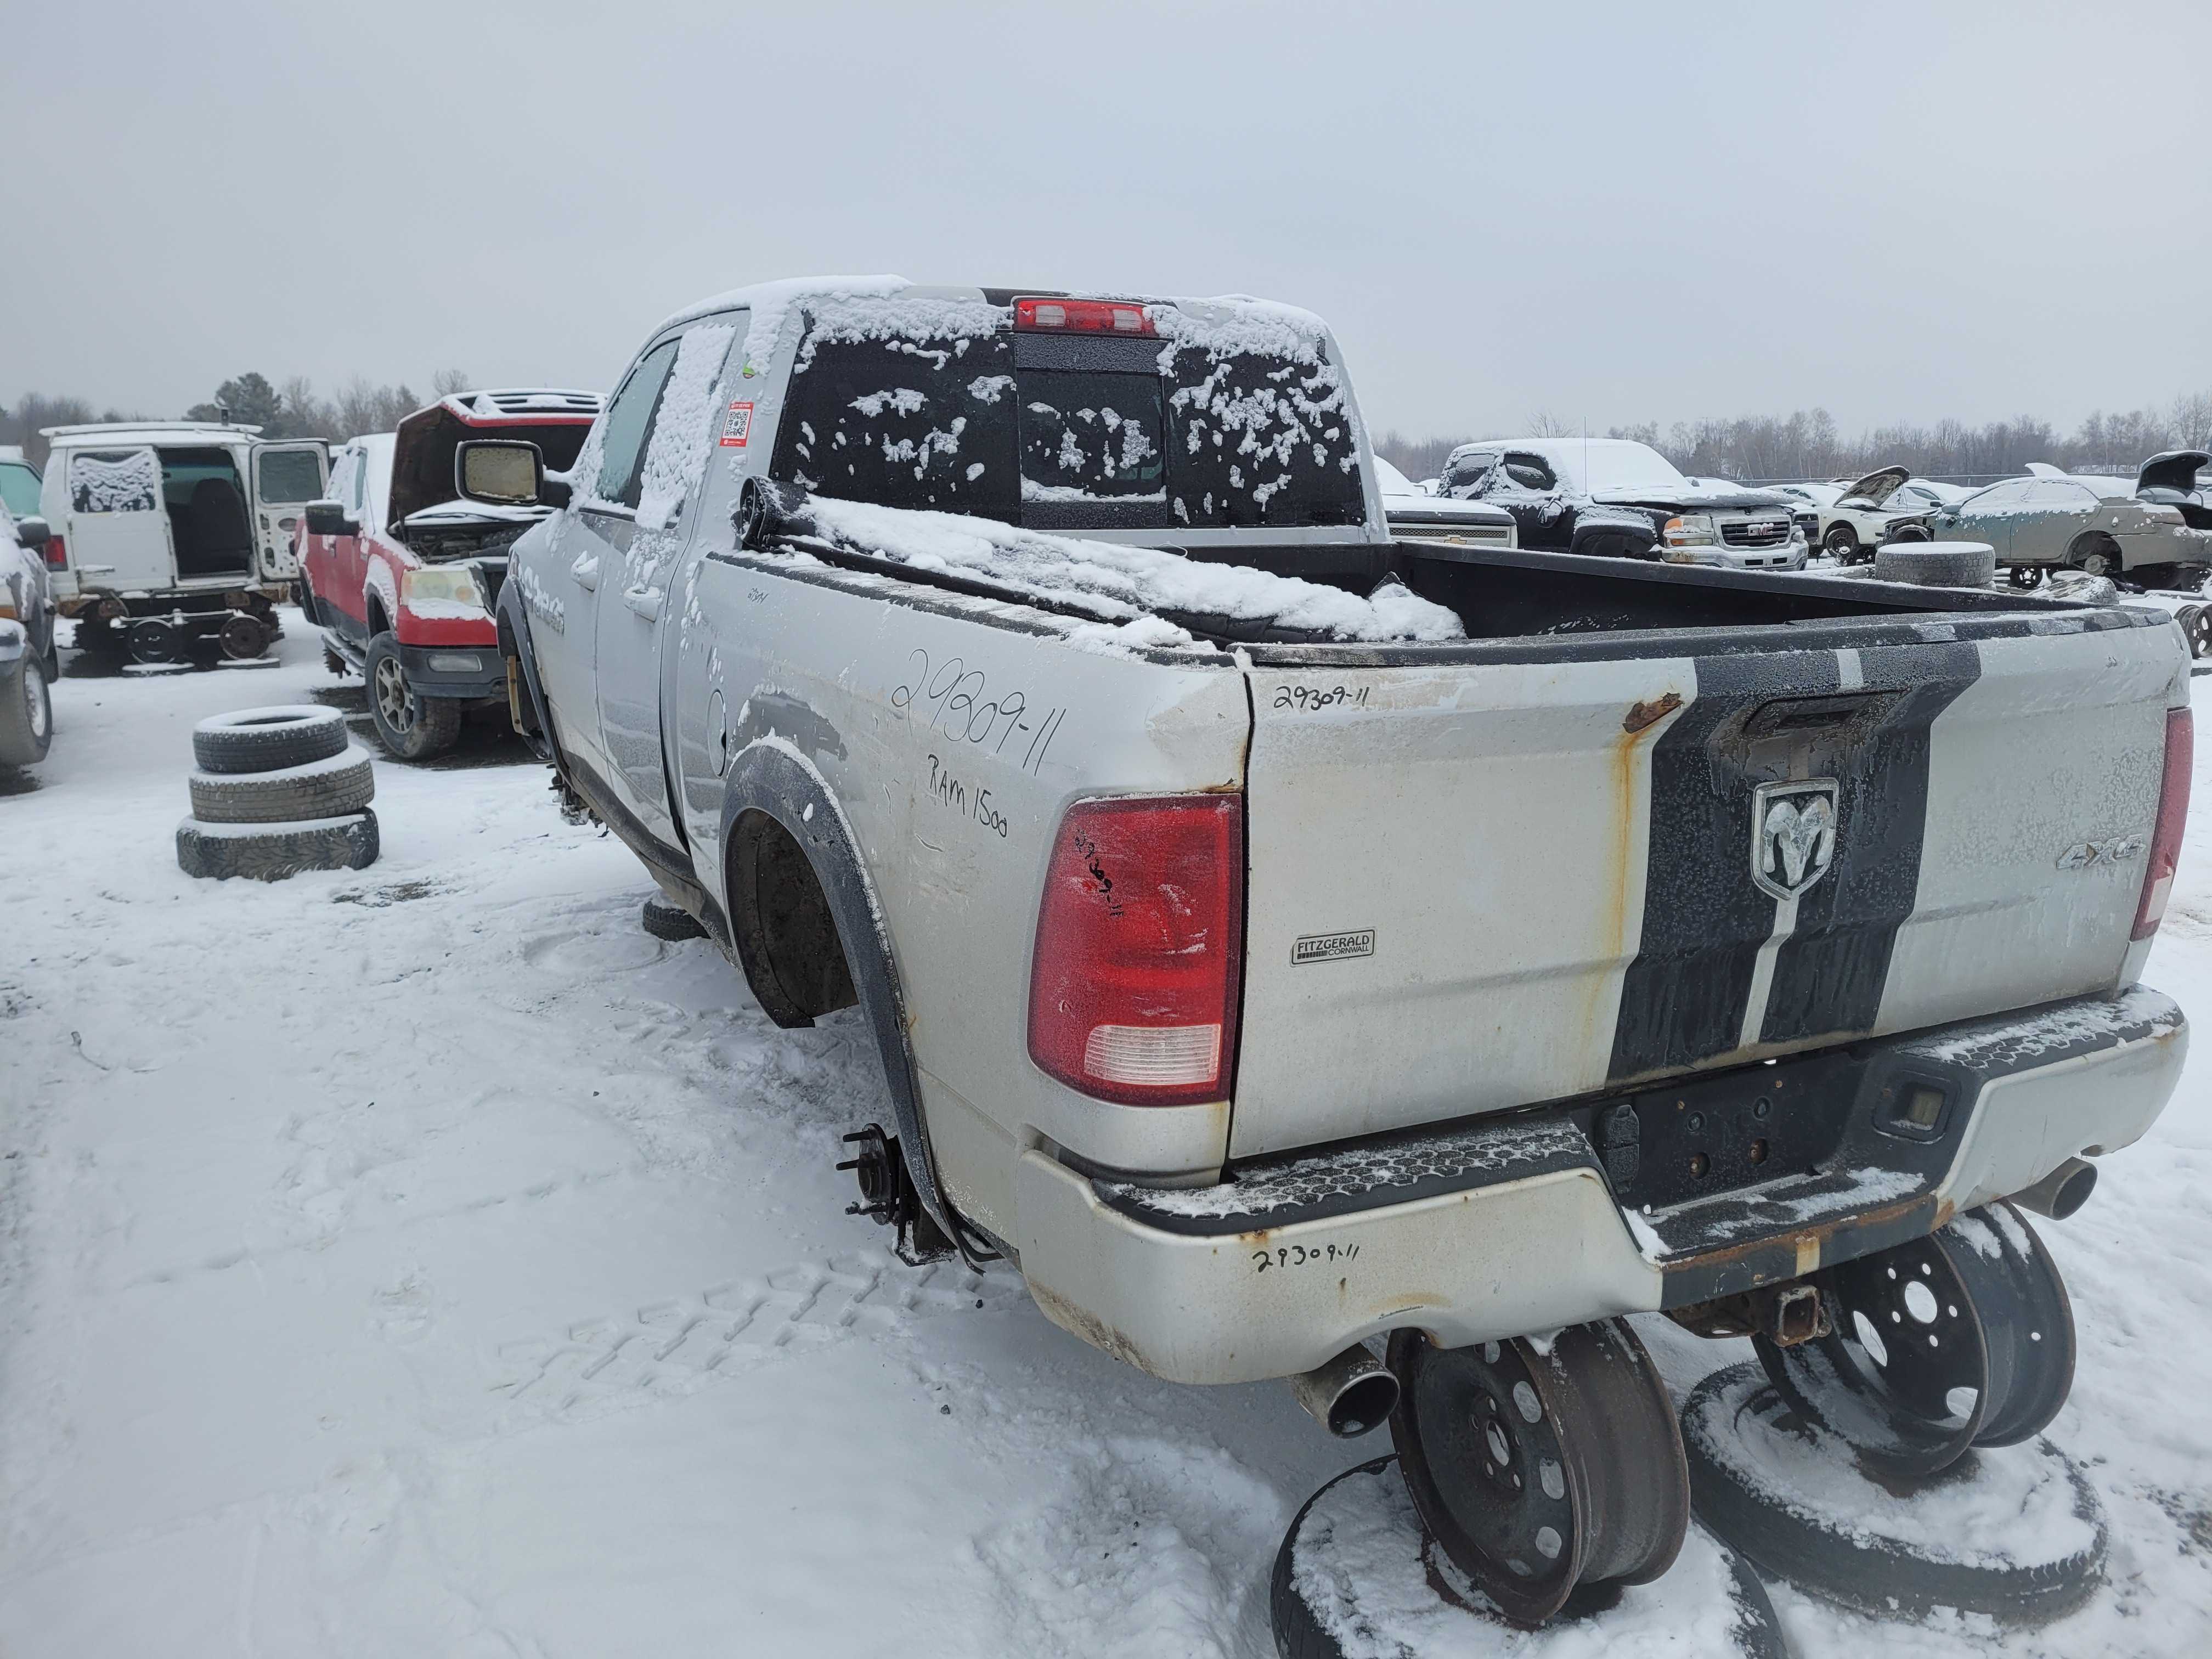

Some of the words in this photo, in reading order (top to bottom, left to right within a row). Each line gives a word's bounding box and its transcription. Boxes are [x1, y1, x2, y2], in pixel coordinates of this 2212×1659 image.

[1747, 524, 1773, 536] GMC
[1273, 686, 1369, 710] 29309-11
[891, 648, 1066, 776] 29309-11
[973, 787, 1007, 838] 1500
[1297, 935, 1370, 952] FITZGERALD
[1328, 945, 1369, 956] CORNWALL
